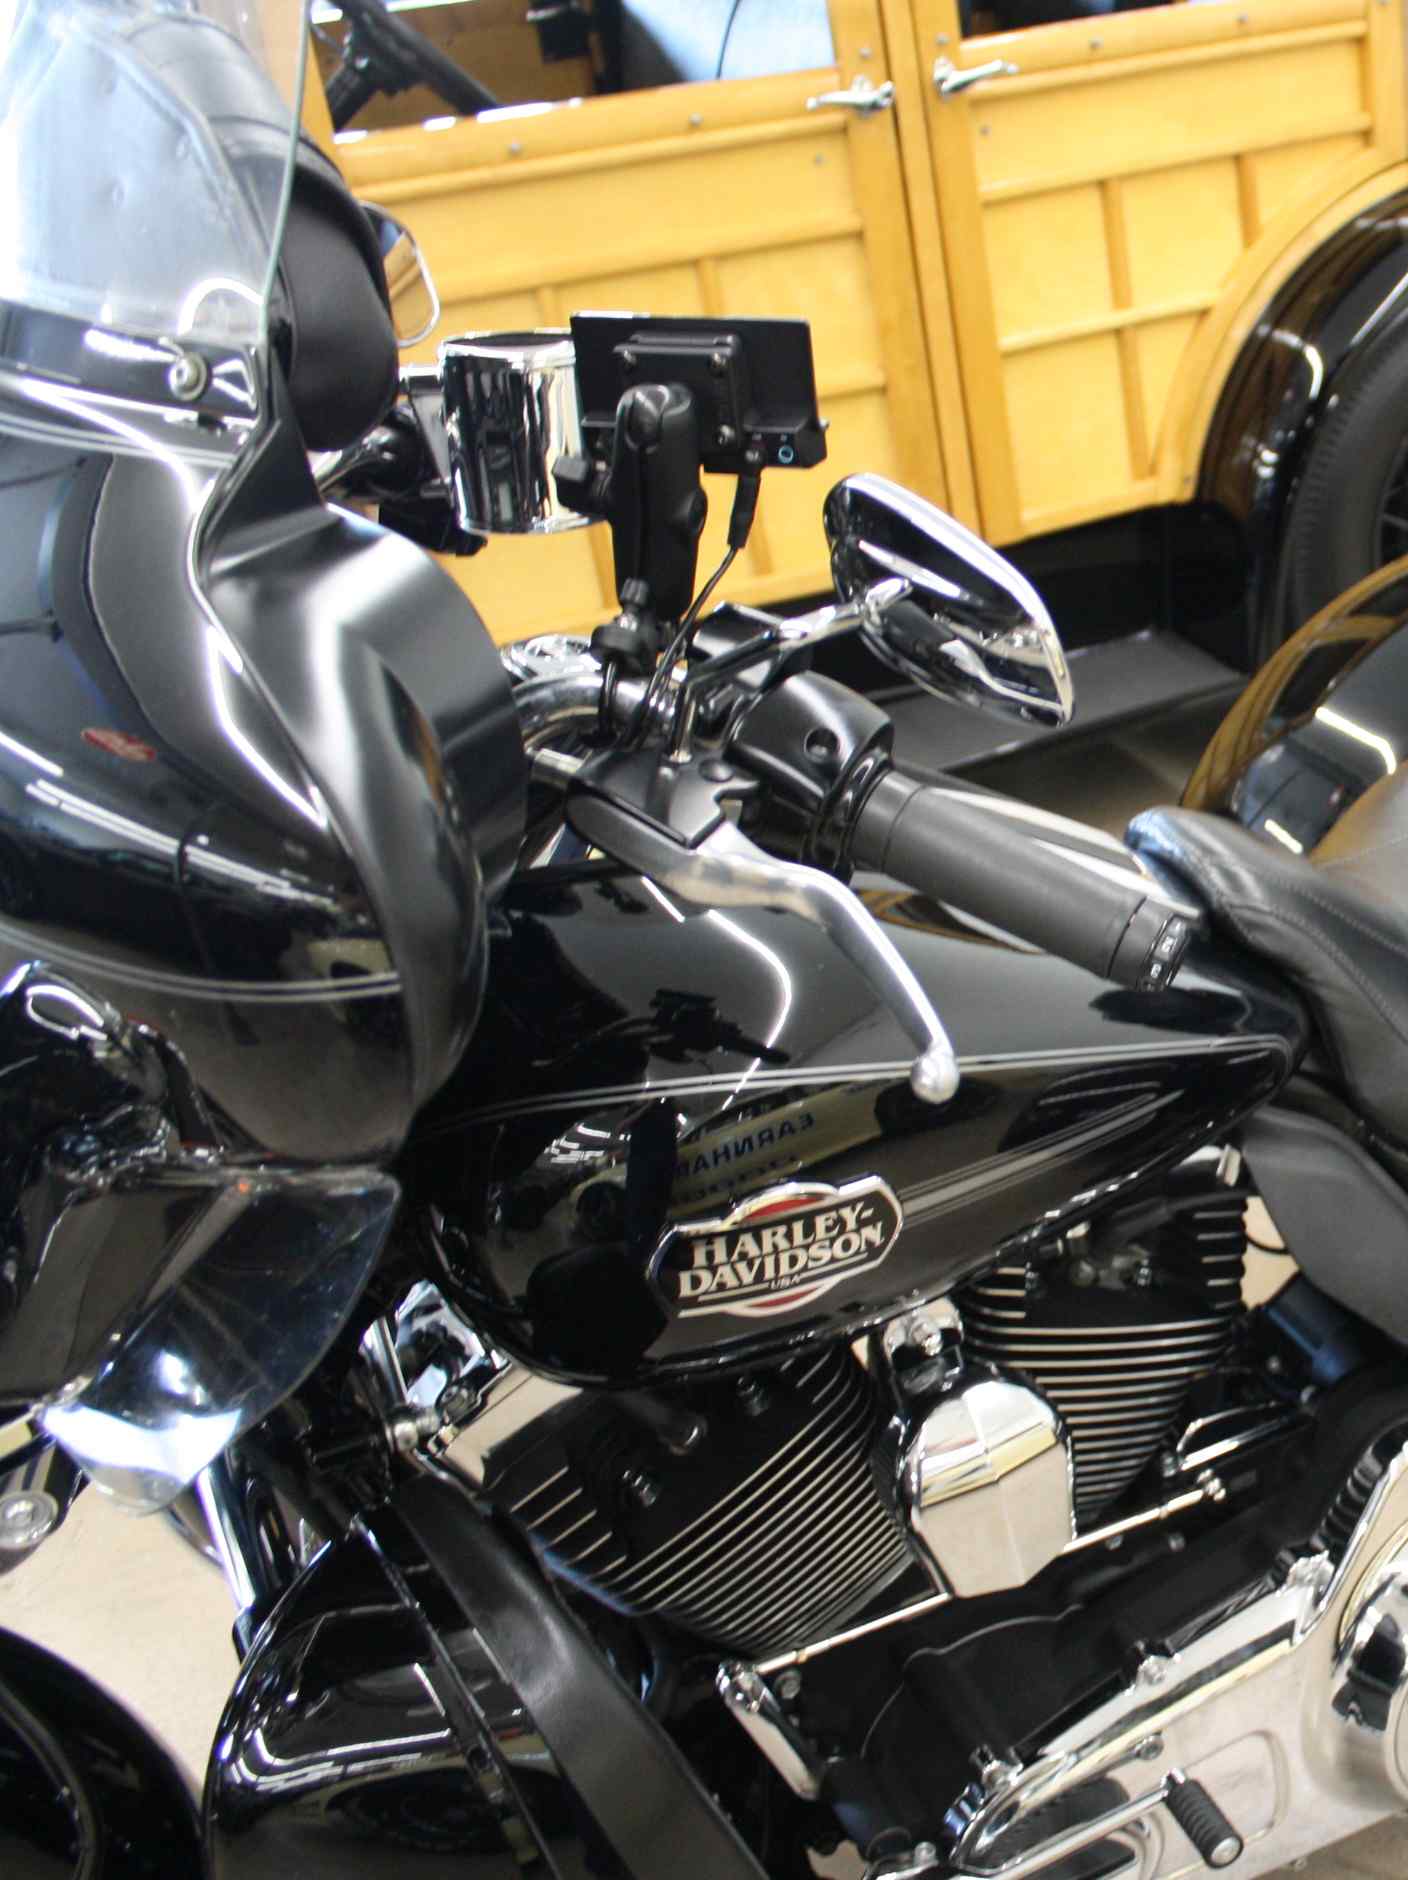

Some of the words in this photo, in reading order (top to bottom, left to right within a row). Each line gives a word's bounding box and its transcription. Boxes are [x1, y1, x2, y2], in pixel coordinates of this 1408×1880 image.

[677, 1220, 885, 1299] DAVIDSON
[691, 1201, 875, 1269] HARLEY-
[769, 1273, 801, 1291] USA
